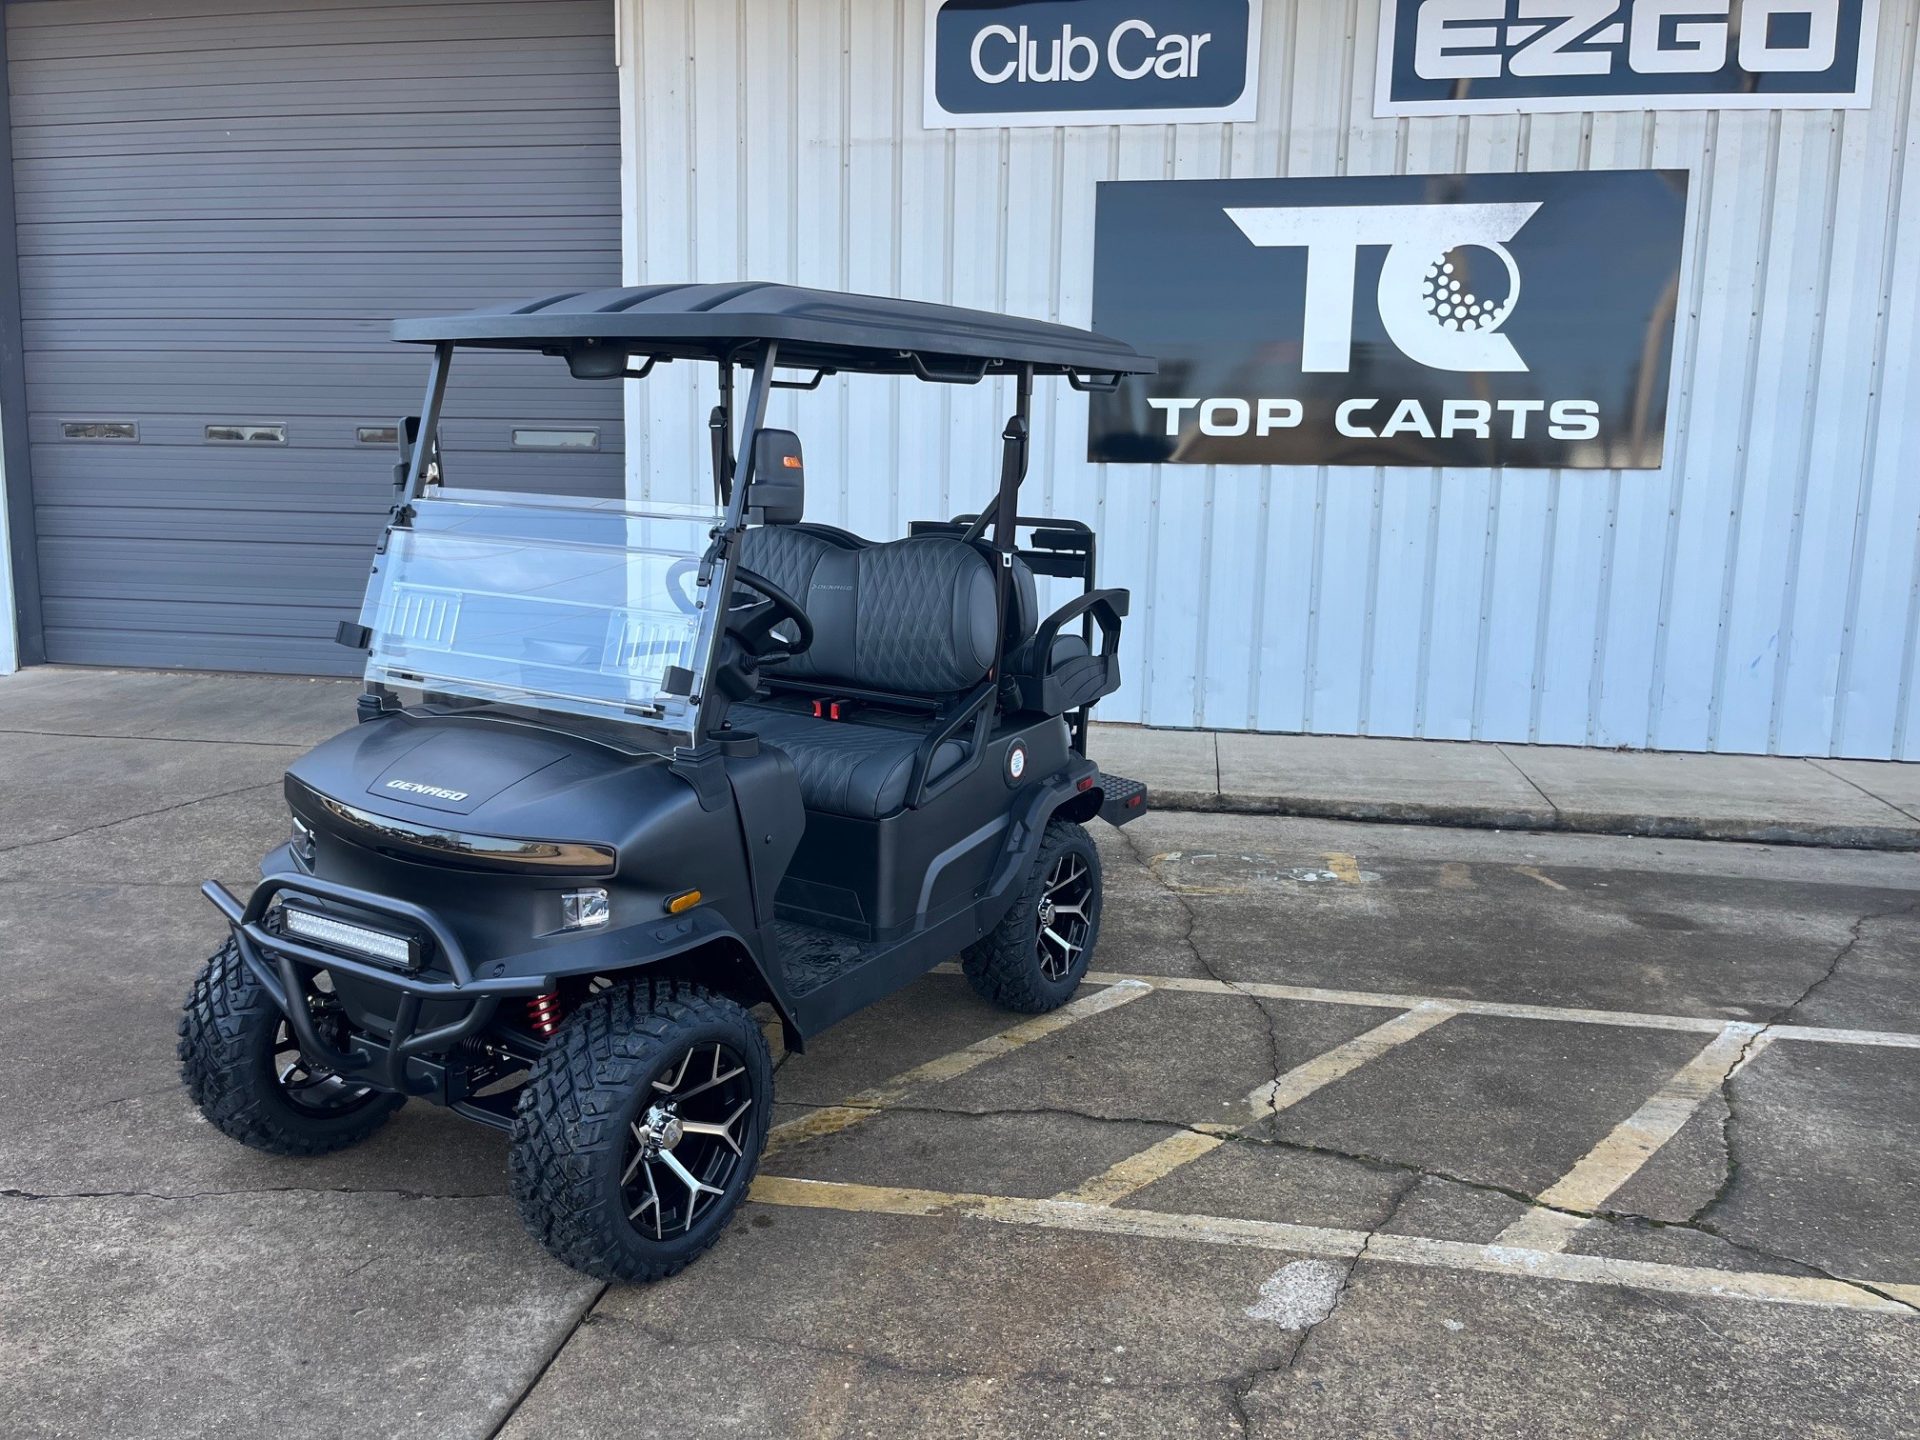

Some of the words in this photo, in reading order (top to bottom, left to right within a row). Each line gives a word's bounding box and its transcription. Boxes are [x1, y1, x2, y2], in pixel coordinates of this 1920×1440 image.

[970, 24, 1099, 84] Club
[1107, 19, 1211, 80] Car
[1147, 398, 1303, 437] TOP
[1335, 399, 1600, 440] CARTS
[386, 780, 469, 802] DENAGO
